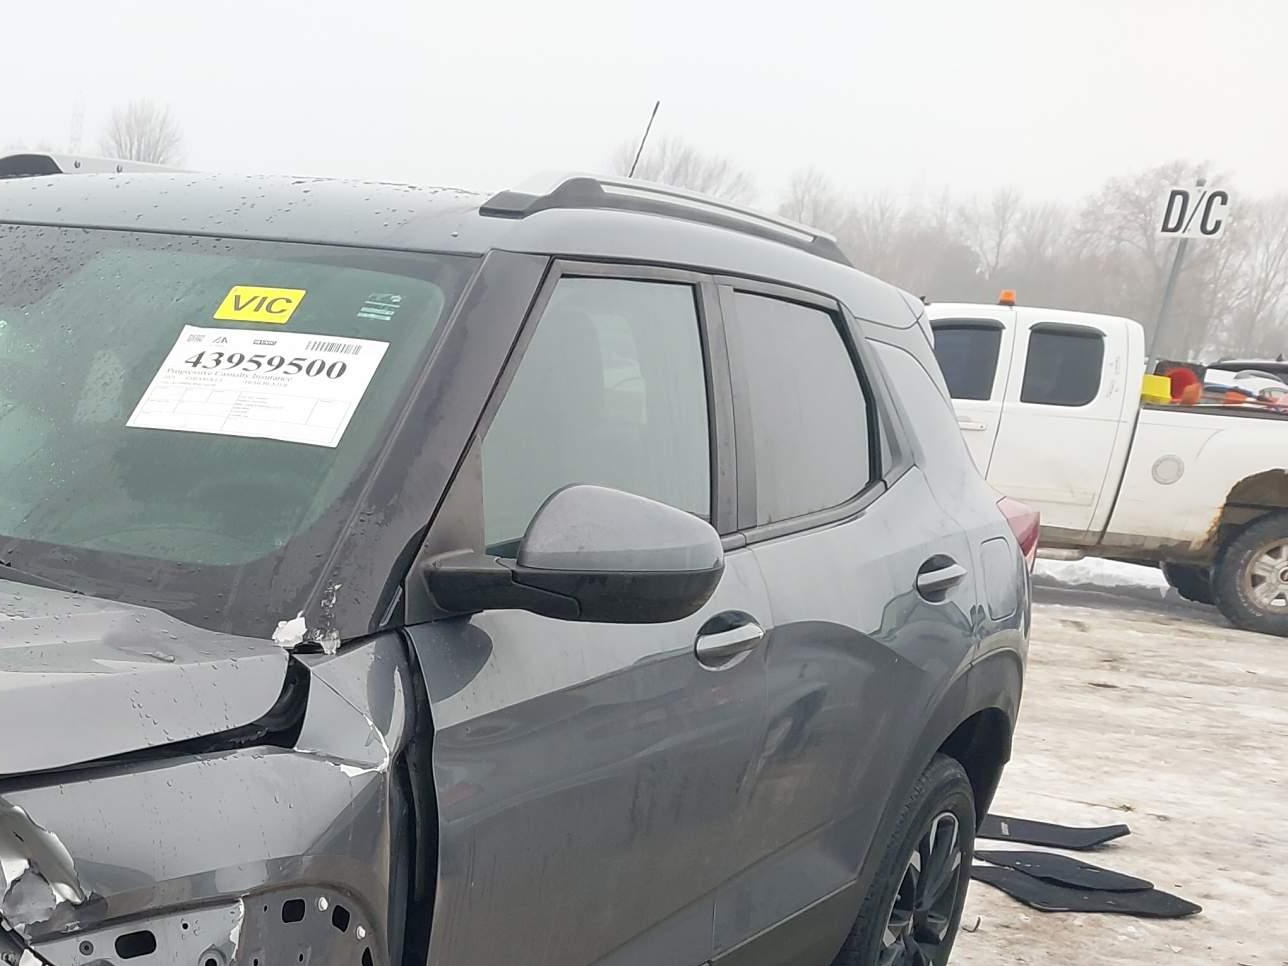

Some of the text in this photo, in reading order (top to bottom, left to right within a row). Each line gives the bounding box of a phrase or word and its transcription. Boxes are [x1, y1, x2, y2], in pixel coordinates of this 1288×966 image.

[1160, 190, 1228, 235] D/C
[233, 294, 293, 314] VIC
[184, 351, 347, 380] 43959500
